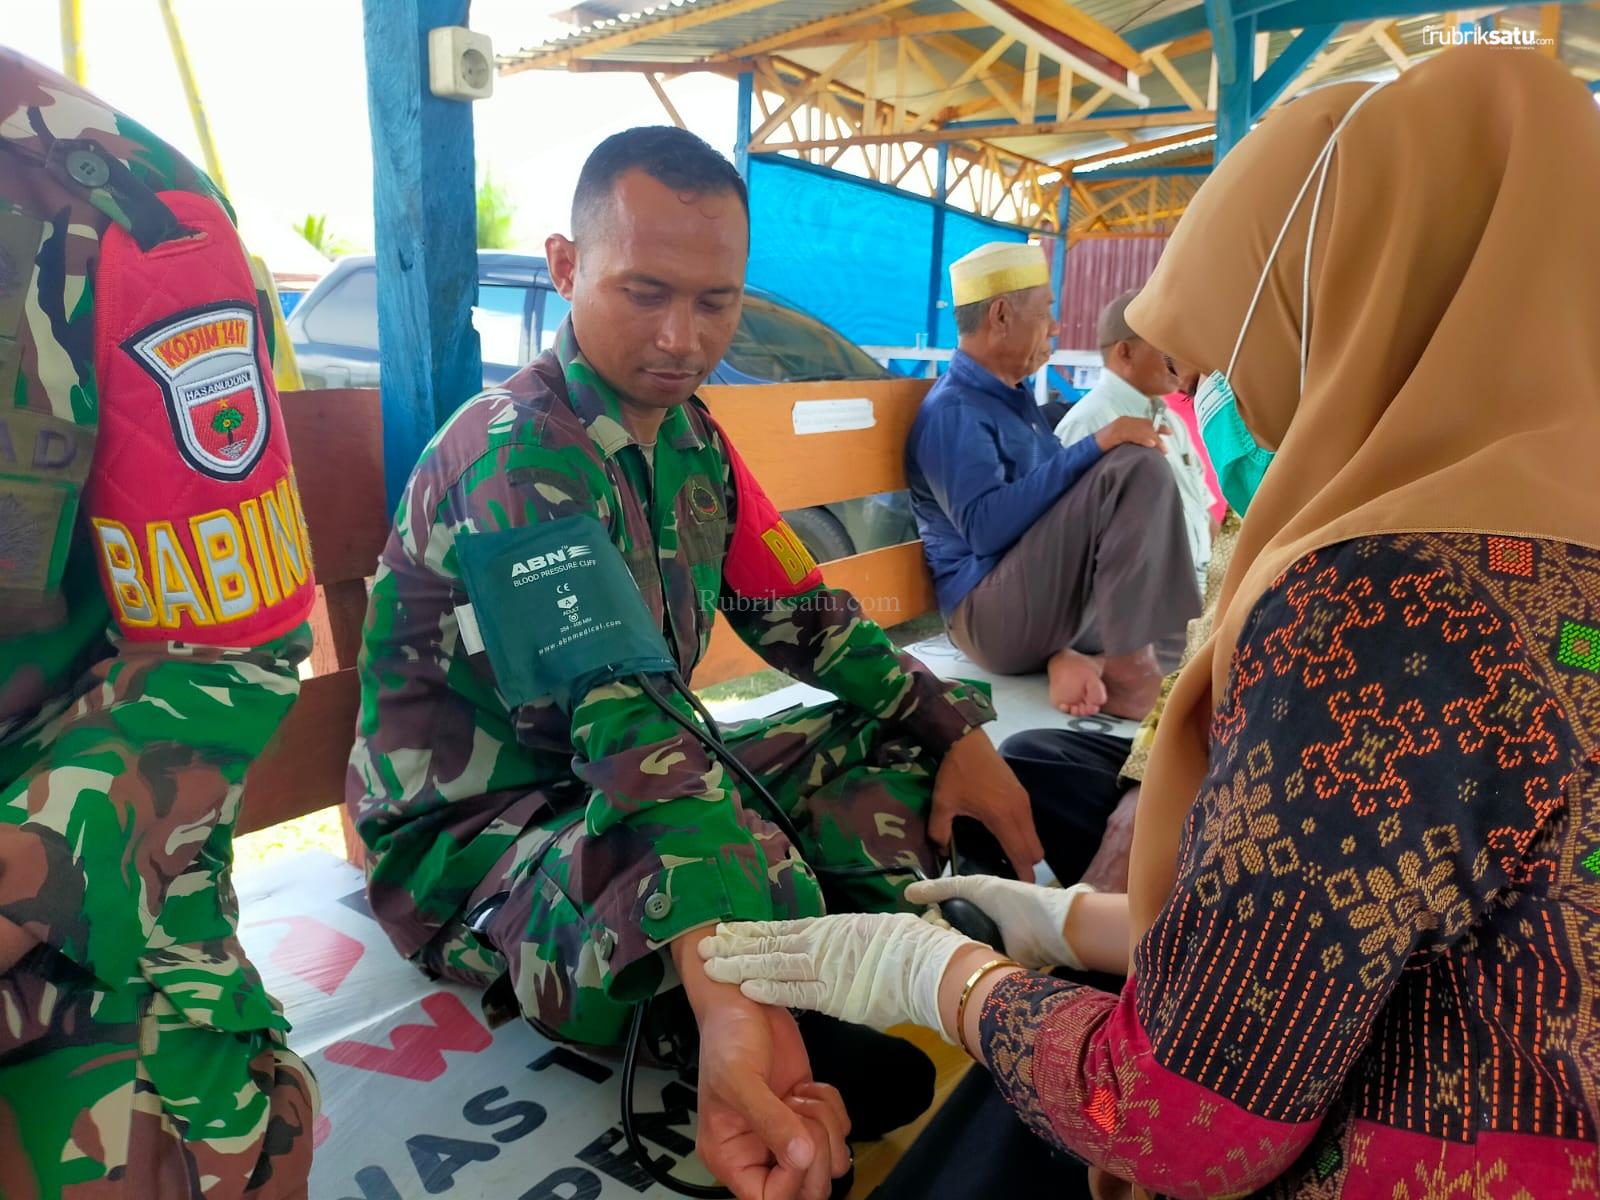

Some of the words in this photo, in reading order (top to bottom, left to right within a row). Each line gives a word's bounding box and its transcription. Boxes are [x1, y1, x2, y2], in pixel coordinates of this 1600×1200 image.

[157, 323, 220, 368] KODIM
[186, 372, 250, 401] HASANUDDIN
[92, 476, 313, 628] BABIN
[511, 549, 567, 578] ABN
[513, 573, 540, 588] BLOOD
[541, 562, 579, 578] PRESSURE
[579, 559, 597, 567] CUFF
